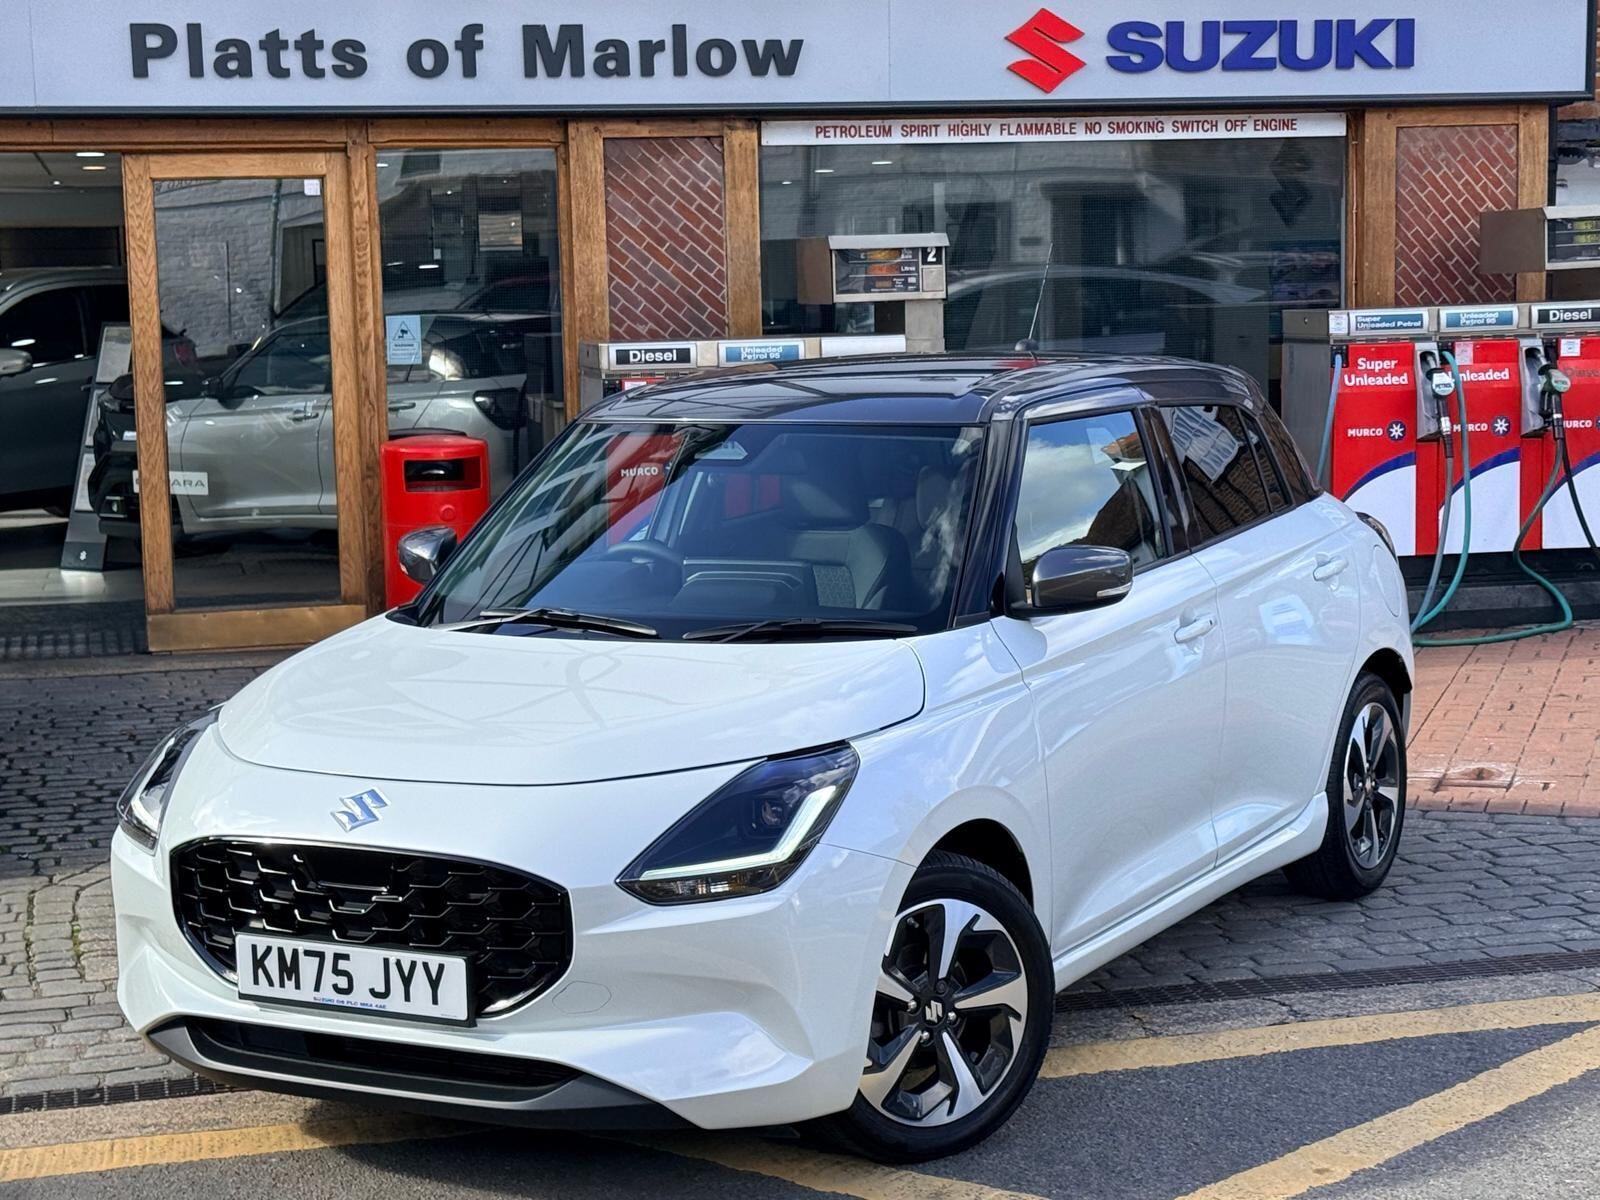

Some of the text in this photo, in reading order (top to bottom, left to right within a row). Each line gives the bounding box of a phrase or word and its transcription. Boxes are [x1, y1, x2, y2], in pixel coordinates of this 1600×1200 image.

[130, 22, 804, 79] Platts of Marlow
[1106, 18, 1416, 73] SUZUKI
[815, 118, 1297, 139] PETROLEUM SPIRIT HIGHLY FLAMMABLE NO SMOKING SWITCH OFF ENGINE
[926, 247, 937, 262] 2
[1460, 311, 1499, 319] Unleaded
[1549, 308, 1592, 321] Diesel
[1357, 320, 1421, 329] Unleaded Petrol
[629, 349, 678, 363] Diesel
[740, 353, 767, 361] Petrol
[1357, 357, 1398, 372] Super
[1343, 373, 1409, 387] Unleaded
[1347, 427, 1383, 438] MURCO
[1453, 423, 1488, 433] MRCO
[621, 466, 659, 477] MURCO
[171, 479, 205, 488] ARA
[251, 943, 446, 1006] KM75 JYY
